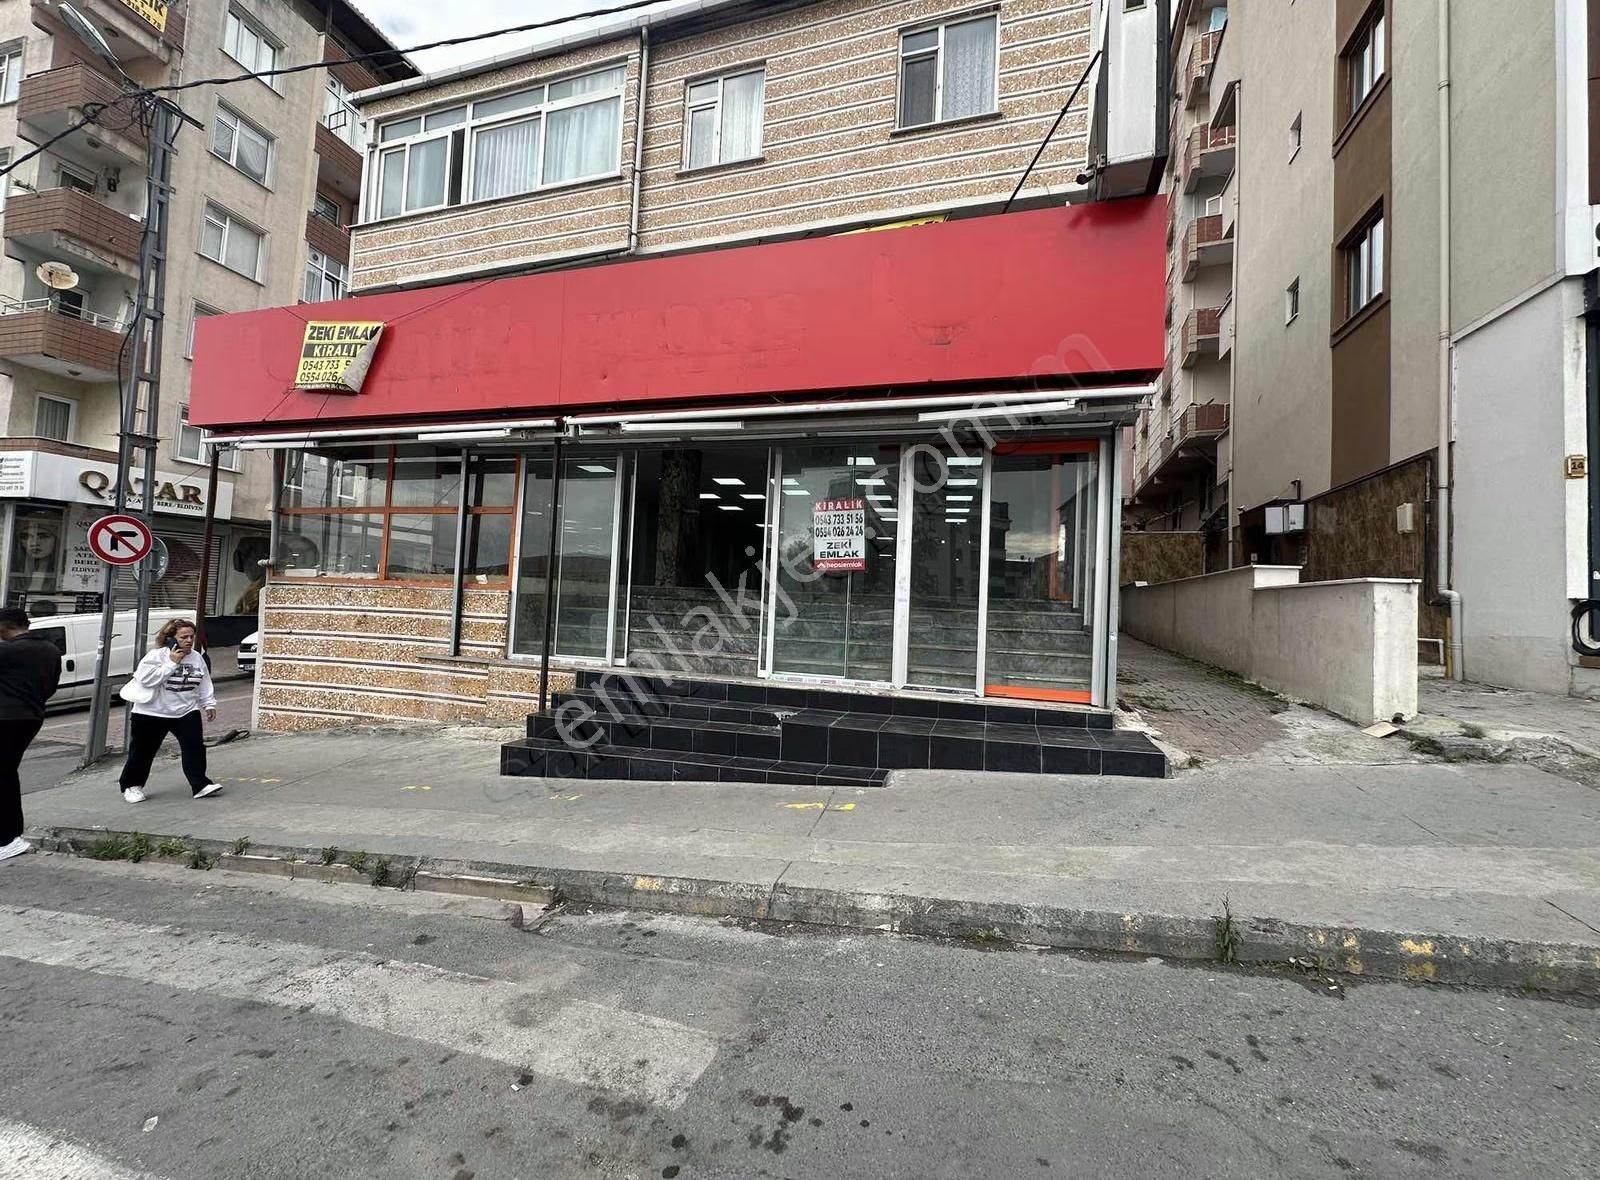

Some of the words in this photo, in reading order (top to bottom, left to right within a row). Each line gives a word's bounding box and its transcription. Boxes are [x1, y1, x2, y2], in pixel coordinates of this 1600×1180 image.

[308, 325, 337, 340] ZEKİ
[302, 360, 324, 371] 0543
[324, 359, 340, 371] 733
[299, 372, 320, 382] 0554
[321, 371, 338, 382] 026
[815, 514, 831, 525] 0543
[832, 513, 845, 525] 733
[846, 513, 854, 524] 51
[855, 512, 864, 524] 56
[832, 526, 845, 537] 026
[826, 538, 852, 550] ZEKİ
[819, 550, 860, 559] EMLAK
